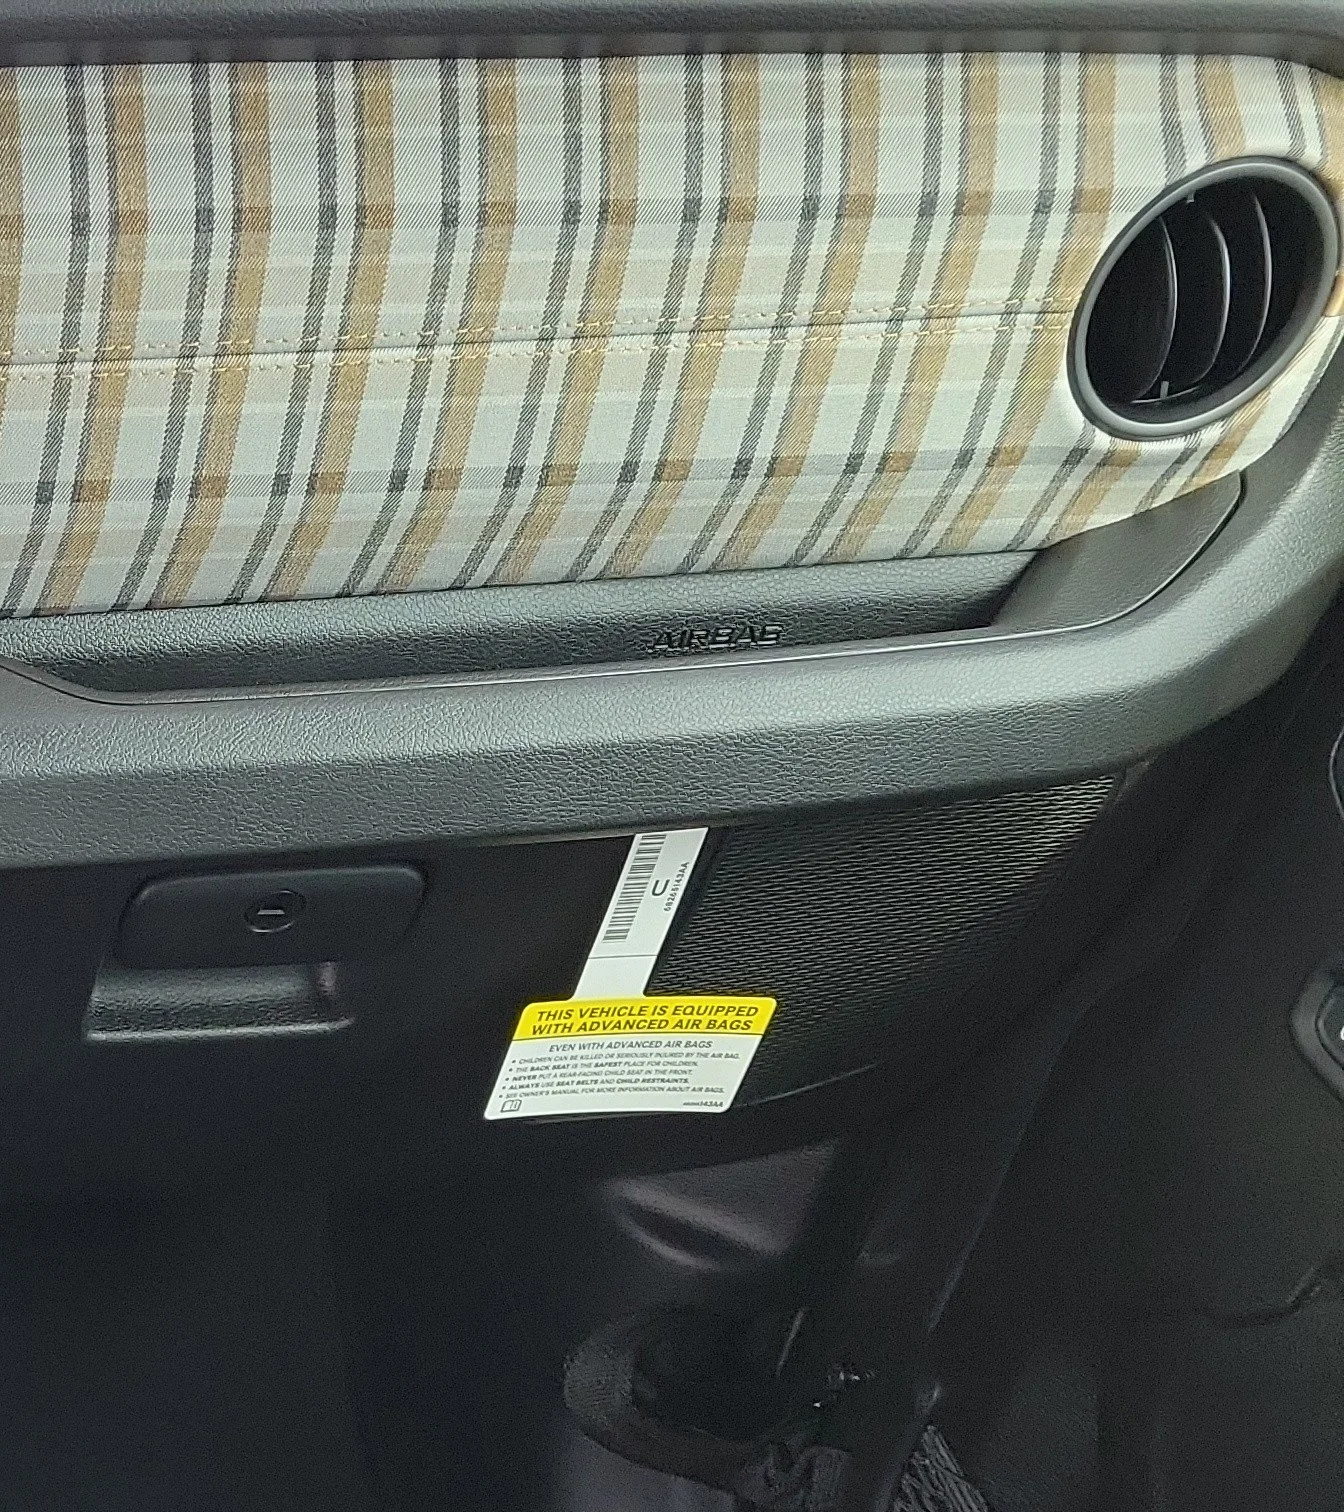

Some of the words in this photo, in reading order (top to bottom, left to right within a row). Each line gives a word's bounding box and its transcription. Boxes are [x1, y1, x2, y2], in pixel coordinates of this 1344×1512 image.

[537, 1009, 575, 1021] THIS
[579, 1006, 649, 1018] VEHICLE
[651, 1005, 668, 1016] IS
[672, 1005, 759, 1017] EQUIPPED
[532, 1022, 574, 1035] WITH
[576, 1019, 668, 1032] ADVANCED
[671, 1018, 703, 1030] AIR
[706, 1018, 753, 1030] BAGS
[549, 1043, 576, 1053] EVEN
[578, 1041, 605, 1051] WITH
[605, 1040, 663, 1050] ADVANCED
[664, 1040, 683, 1049] AIR
[684, 1040, 713, 1049] BAGS
